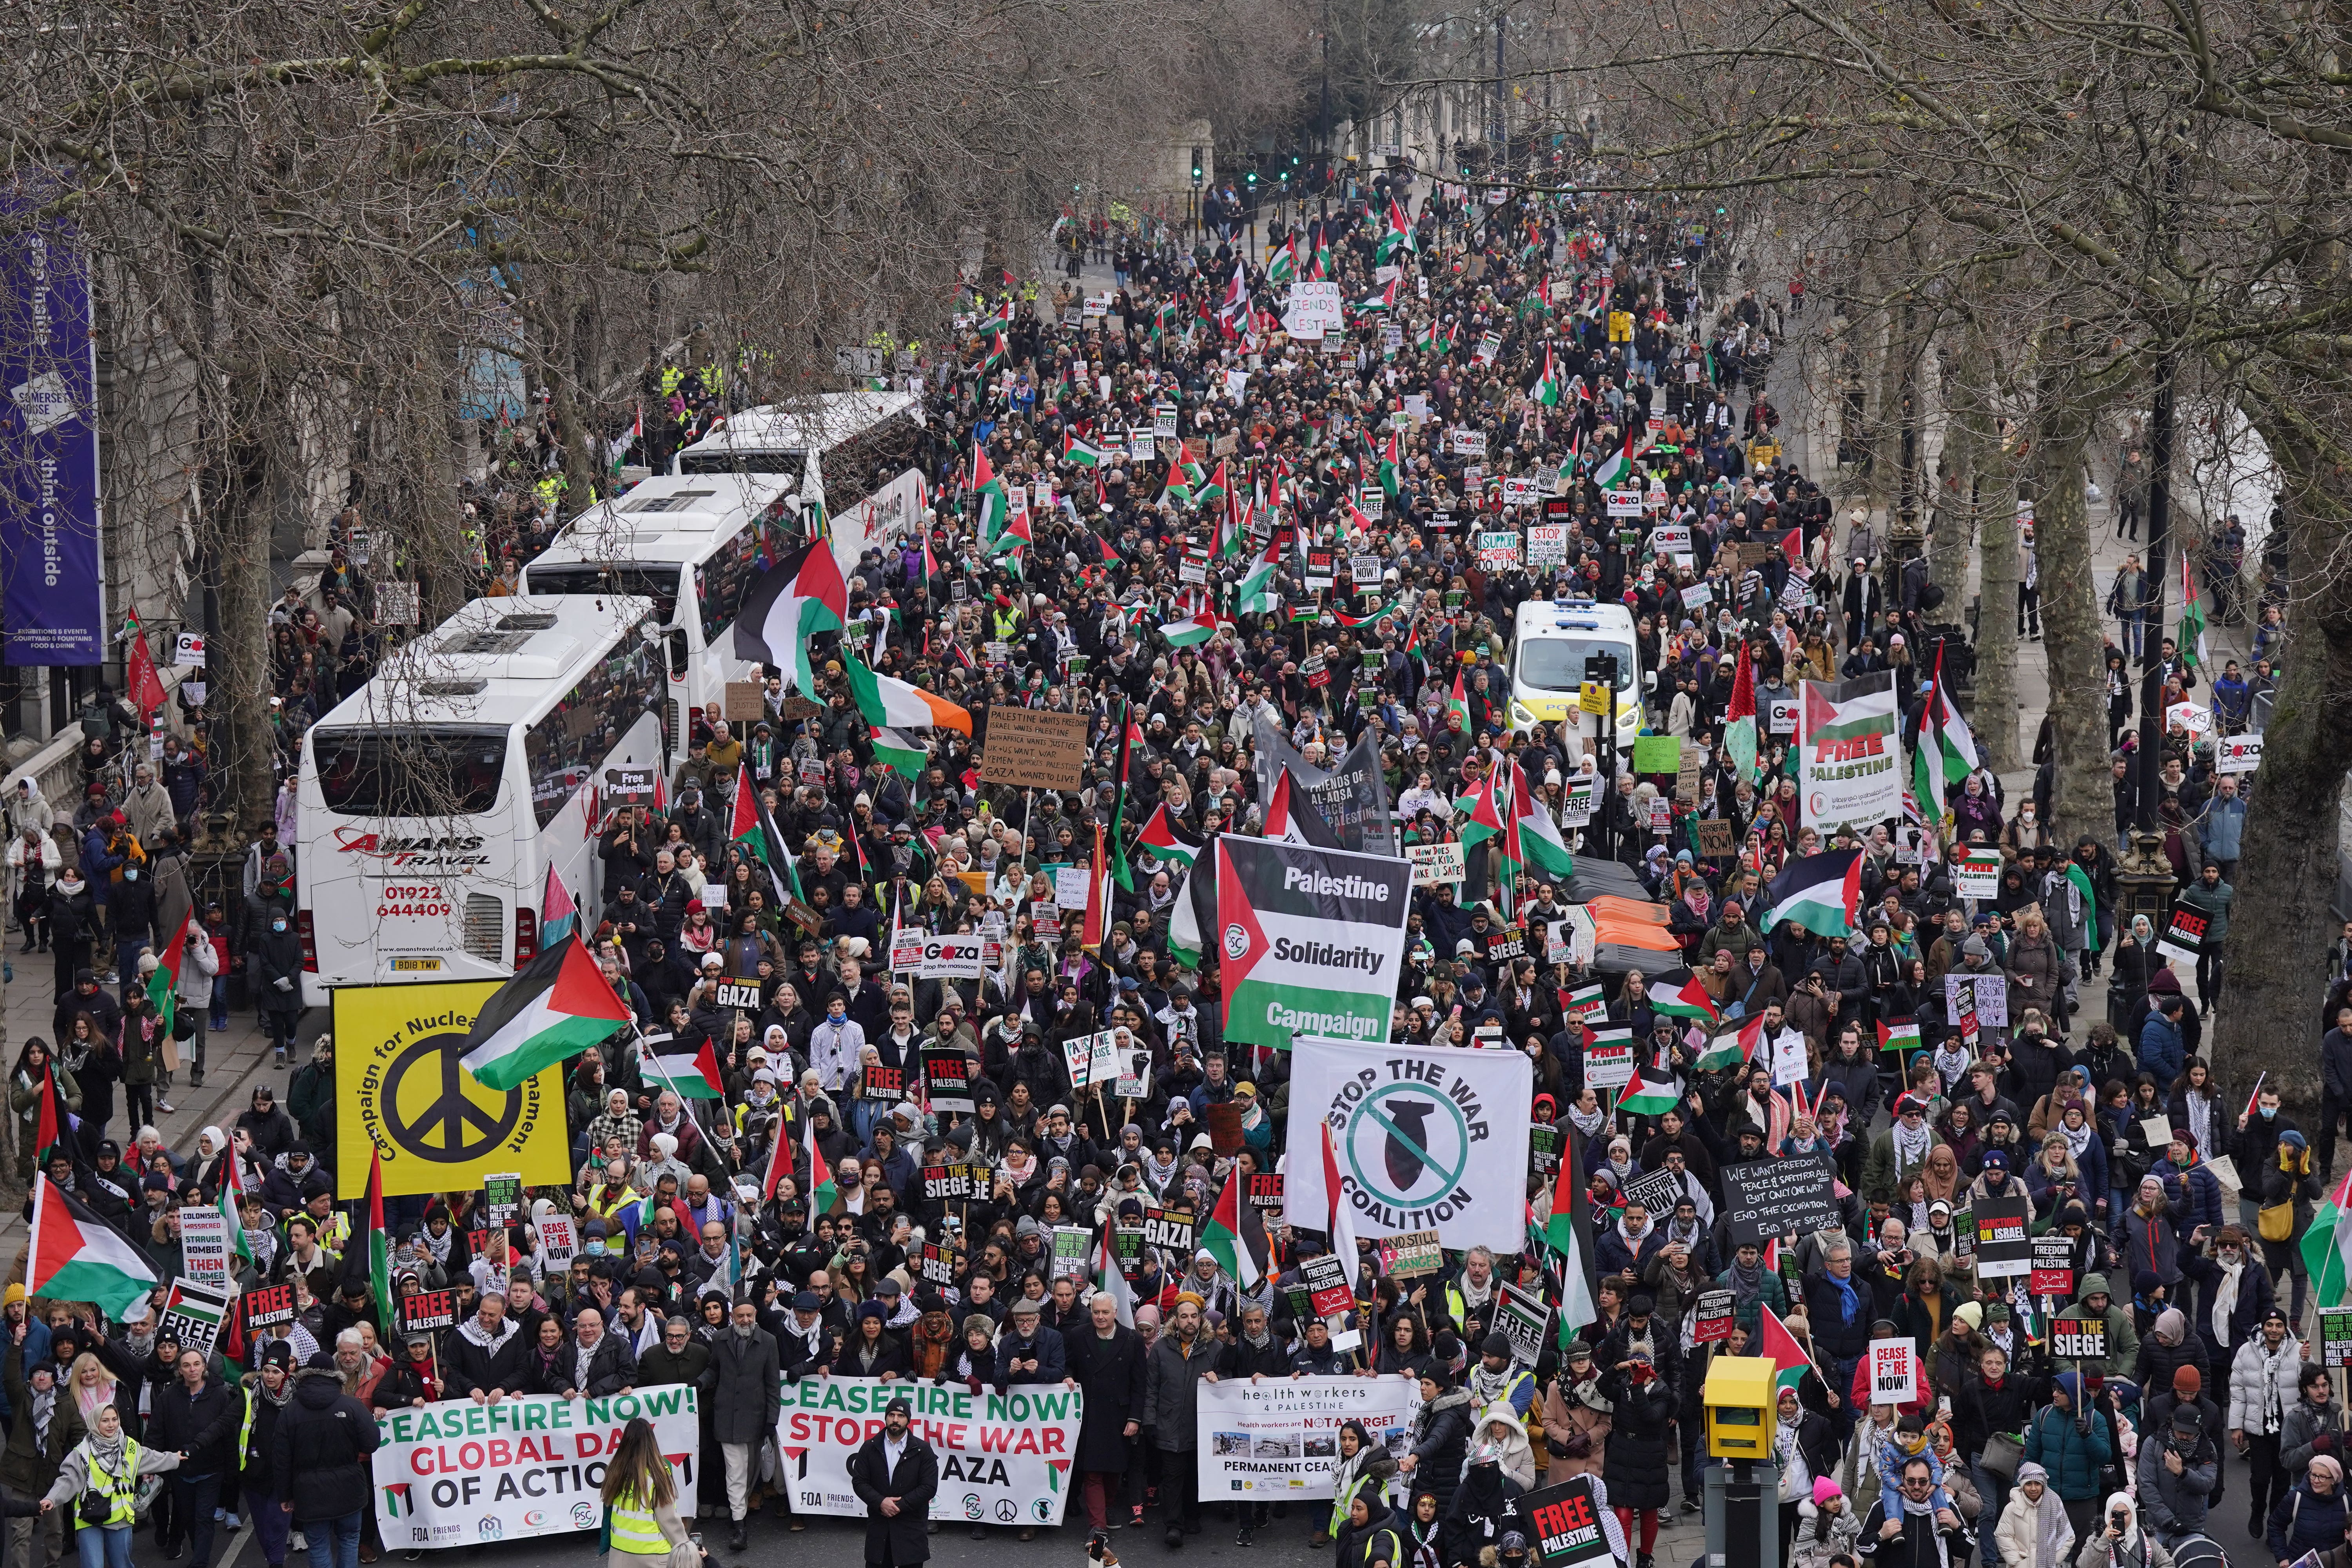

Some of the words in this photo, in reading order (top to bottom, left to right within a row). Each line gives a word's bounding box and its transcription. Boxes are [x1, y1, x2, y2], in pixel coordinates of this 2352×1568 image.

[19, 392, 68, 403] SOMERSET
[20, 404, 49, 414] HOUSE
[41, 458, 59, 514] think
[1535, 528, 1560, 539] STOP
[43, 513, 61, 586] outside
[1478, 534, 1482, 551] I
[1483, 534, 1516, 548] SUPPORT
[1479, 548, 1517, 561] CEASEFIRE
[1479, 560, 1493, 571] DO
[1583, 697, 1602, 706] WARNING
[991, 711, 1036, 723] PALESTINE
[1040, 716, 1060, 725] WANTS
[1062, 719, 1088, 728] FREEDOM
[1035, 726, 1069, 737] PALESTINE
[1003, 735, 1024, 743] AFRICA
[1048, 740, 1078, 750] JUSTICE
[1816, 731, 1884, 763] FREE
[1014, 748, 1035, 756] WANT
[1039, 750, 1056, 759] WAR
[987, 755, 1013, 764] YEMEN
[1017, 758, 1043, 766] SUPPORTS
[1046, 761, 1082, 771] PALESTINE
[1810, 755, 1893, 782] PALESTINE
[622, 773, 644, 784] Free
[985, 767, 1015, 778] GAZA
[1020, 770, 1045, 780] WANTS
[610, 782, 653, 793] Palestine
[392, 853, 491, 866] TRAVEL
[1283, 866, 1389, 902] Palestine
[385, 887, 442, 899] 01922
[377, 904, 451, 916] 644409
[1274, 937, 1384, 975] Solidarity
[421, 961, 437, 970] TMV
[406, 1011, 477, 1035] Nuclea
[1267, 1001, 1379, 1043] Campaign
[374, 1030, 401, 1059] for
[1328, 1067, 1377, 1131] STOP
[1386, 1059, 1446, 1087] THE
[1450, 1076, 1489, 1143] WAR
[357, 1063, 396, 1161] Campaign
[1726, 1168, 1747, 1181] WE
[1751, 1164, 1777, 1178] WANT
[1741, 1179, 1771, 1191] PEACE
[1779, 1173, 1802, 1184] SAFETY
[1816, 1169, 1830, 1178] ALL
[1341, 1174, 1472, 1230] COALITION
[1746, 1192, 1766, 1204] BUT
[1769, 1187, 1790, 1200] ONLY
[1791, 1185, 1805, 1196] ONE
[1734, 1210, 1757, 1222] END
[1759, 1205, 1780, 1216] THE
[1758, 1222, 1780, 1235] END
[1783, 1218, 1801, 1230] THE
[1828, 1211, 1840, 1220] OF
[1979, 1216, 2023, 1230] SANCTIONS
[1980, 1229, 1993, 1241] ON
[1994, 1226, 2026, 1240] ISRAEL
[186, 1245, 222, 1253] BOMBED
[1381, 1236, 1405, 1252] AND
[1407, 1232, 1438, 1245] STILL
[2035, 1245, 2069, 1254] FREEDOM
[1385, 1250, 1394, 1262] I
[1397, 1246, 1419, 1259] SEE
[1421, 1243, 1439, 1256] NO
[188, 1259, 223, 1270] THEN
[1387, 1255, 1441, 1274] CHANGES
[2033, 1259, 2070, 1268] PALESTINE
[189, 1271, 225, 1280] BLAMED
[2039, 1272, 2063, 1281] الحرية
[2036, 1281, 2067, 1290] لفلسطين
[247, 1284, 292, 1316] FREE
[249, 1307, 293, 1327] PALESTINE
[2054, 1320, 2077, 1335] END
[2081, 1319, 2103, 1334] THE
[2054, 1334, 2105, 1356] SIEGE
[1877, 1347, 1907, 1360] CEASE
[1878, 1375, 1908, 1391] NOW!
[586, 1387, 696, 1426] NOW!
[987, 1389, 1081, 1422] NOW!
[1278, 1402, 1344, 1411] PALESTINE
[980, 1426, 1066, 1454] WAR
[410, 1436, 564, 1476] GLOBAL
[1224, 1461, 1301, 1472] PERMANENT
[431, 1476, 481, 1508] OF
[494, 1462, 609, 1503] ACTIO
[801, 1492, 821, 1506] FOA
[828, 1494, 853, 1503] FRIENDS
[966, 1501, 980, 1512] PSC
[575, 1512, 591, 1522] PSC
[412, 1528, 429, 1542] FOA
[433, 1525, 461, 1534] FRIENDS
